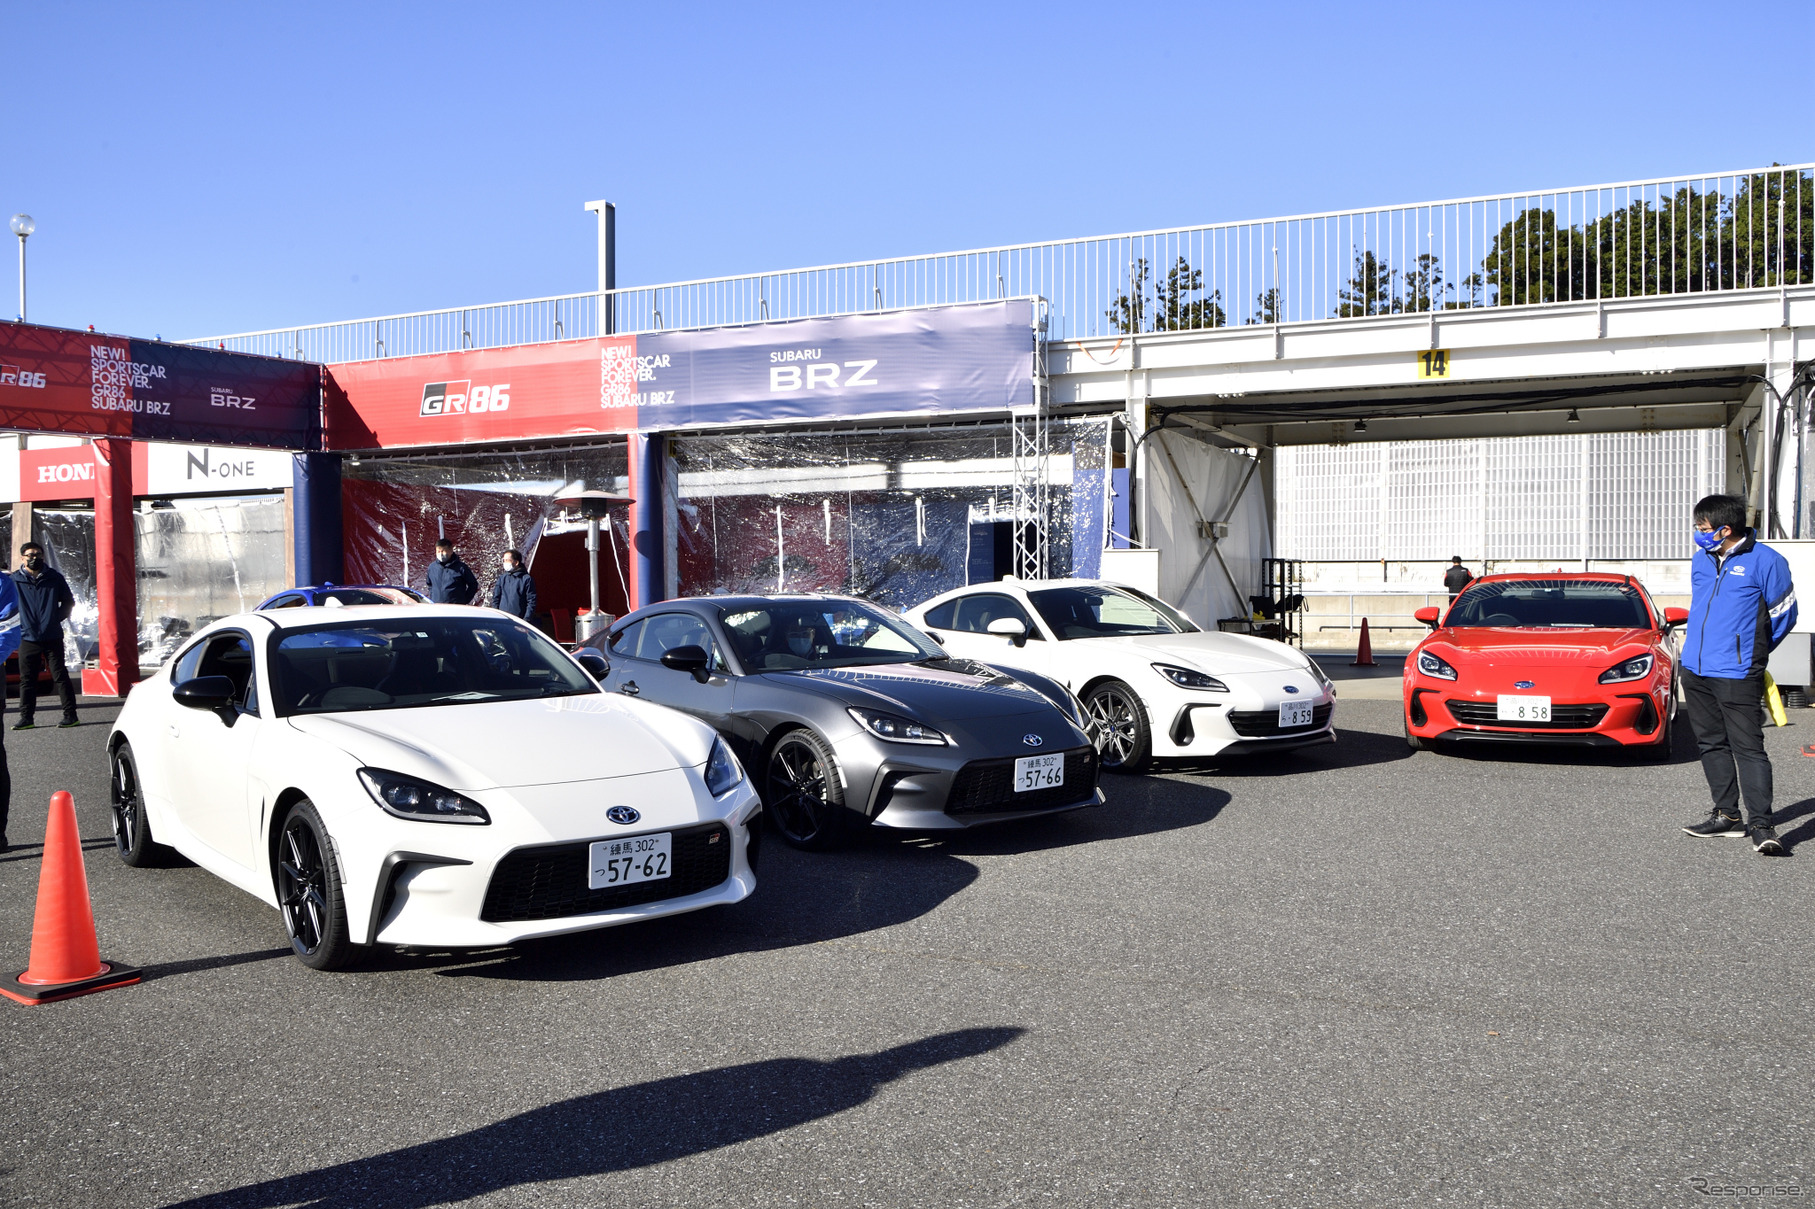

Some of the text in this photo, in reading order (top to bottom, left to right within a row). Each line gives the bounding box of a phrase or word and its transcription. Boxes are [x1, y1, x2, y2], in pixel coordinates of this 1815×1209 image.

[90, 345, 126, 361] NEW!
[601, 345, 632, 360] NEW!
[770, 348, 822, 363] SUBARU
[91, 358, 167, 379] SPORTSCAR
[601, 354, 671, 372] SPORTSCAR
[1422, 351, 1446, 376] 14
[91, 370, 153, 389] FOREVER.
[601, 368, 657, 385] FOREVER.
[770, 359, 878, 392] BRZ
[91, 384, 126, 399] GR86
[210, 386, 234, 395] SUBARU
[600, 382, 631, 396] GR86
[91, 396, 171, 416] SUBARU BRZ
[210, 394, 256, 410] BRZ
[600, 390, 675, 409] SUBARU BRZ
[38, 463, 95, 483] HON
[187, 448, 255, 480] N-ONE
[1042, 756, 1054, 767] 302
[1025, 767, 1061, 788] 57-66
[610, 838, 655, 856] 練馬 302
[608, 852, 667, 883] 57-62
